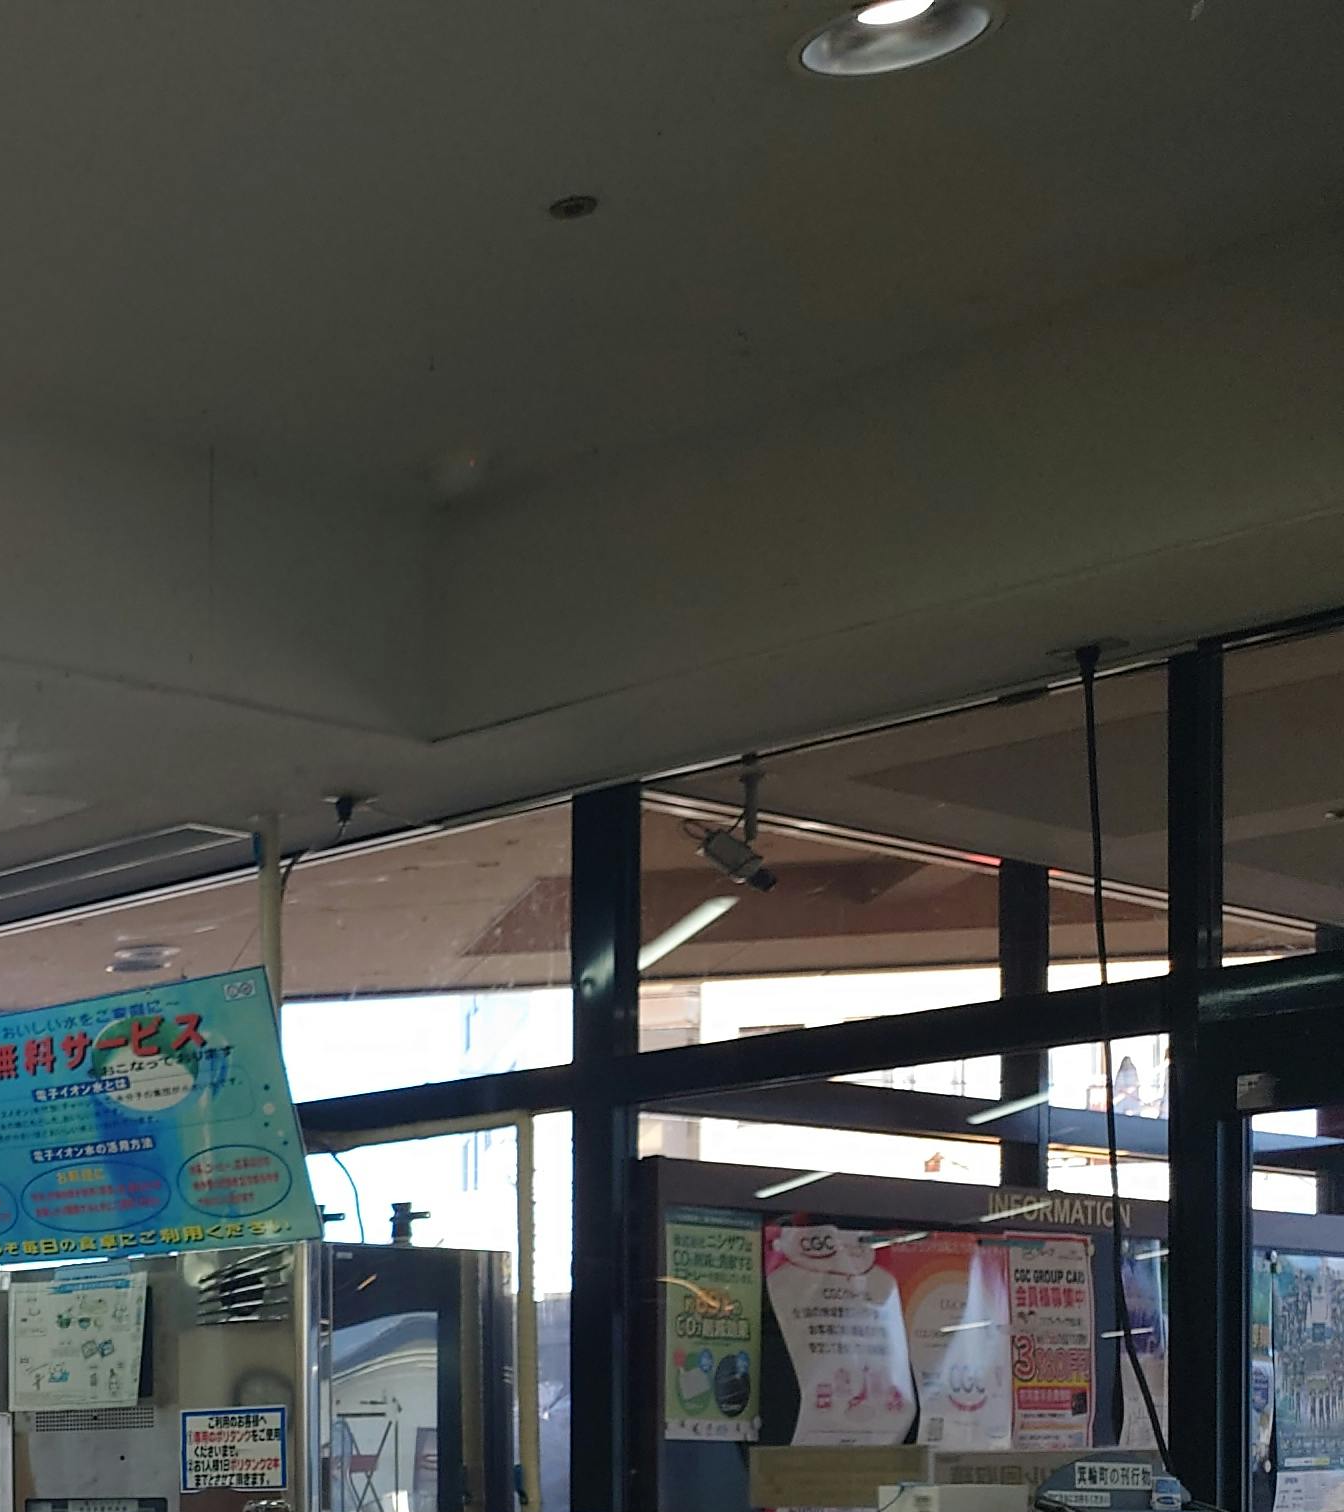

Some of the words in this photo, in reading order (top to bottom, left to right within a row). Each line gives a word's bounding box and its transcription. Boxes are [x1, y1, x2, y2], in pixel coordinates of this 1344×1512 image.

[800, 1236, 835, 1251] CGC
[208, 1415, 267, 1429] ご利用のお客様へ
[1077, 1465, 1152, 1487] 箕輪町の刊行物
